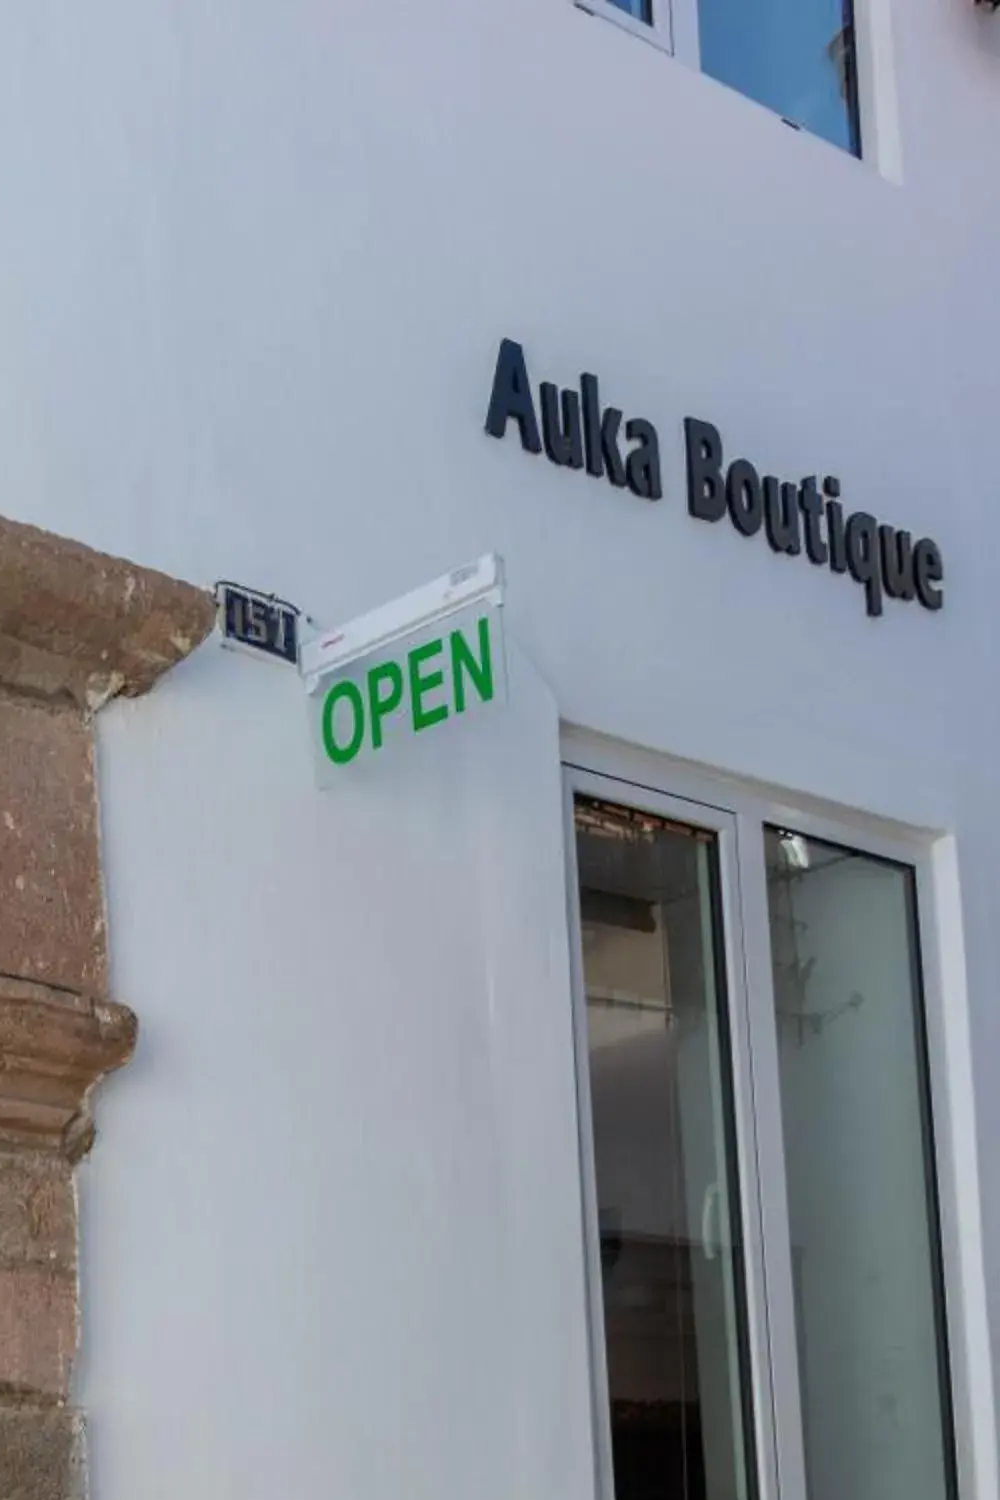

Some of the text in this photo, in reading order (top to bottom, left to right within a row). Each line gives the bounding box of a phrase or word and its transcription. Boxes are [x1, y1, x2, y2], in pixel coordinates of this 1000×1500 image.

[485, 337, 944, 617] Auka Boutique
[321, 618, 494, 765] OPEN
